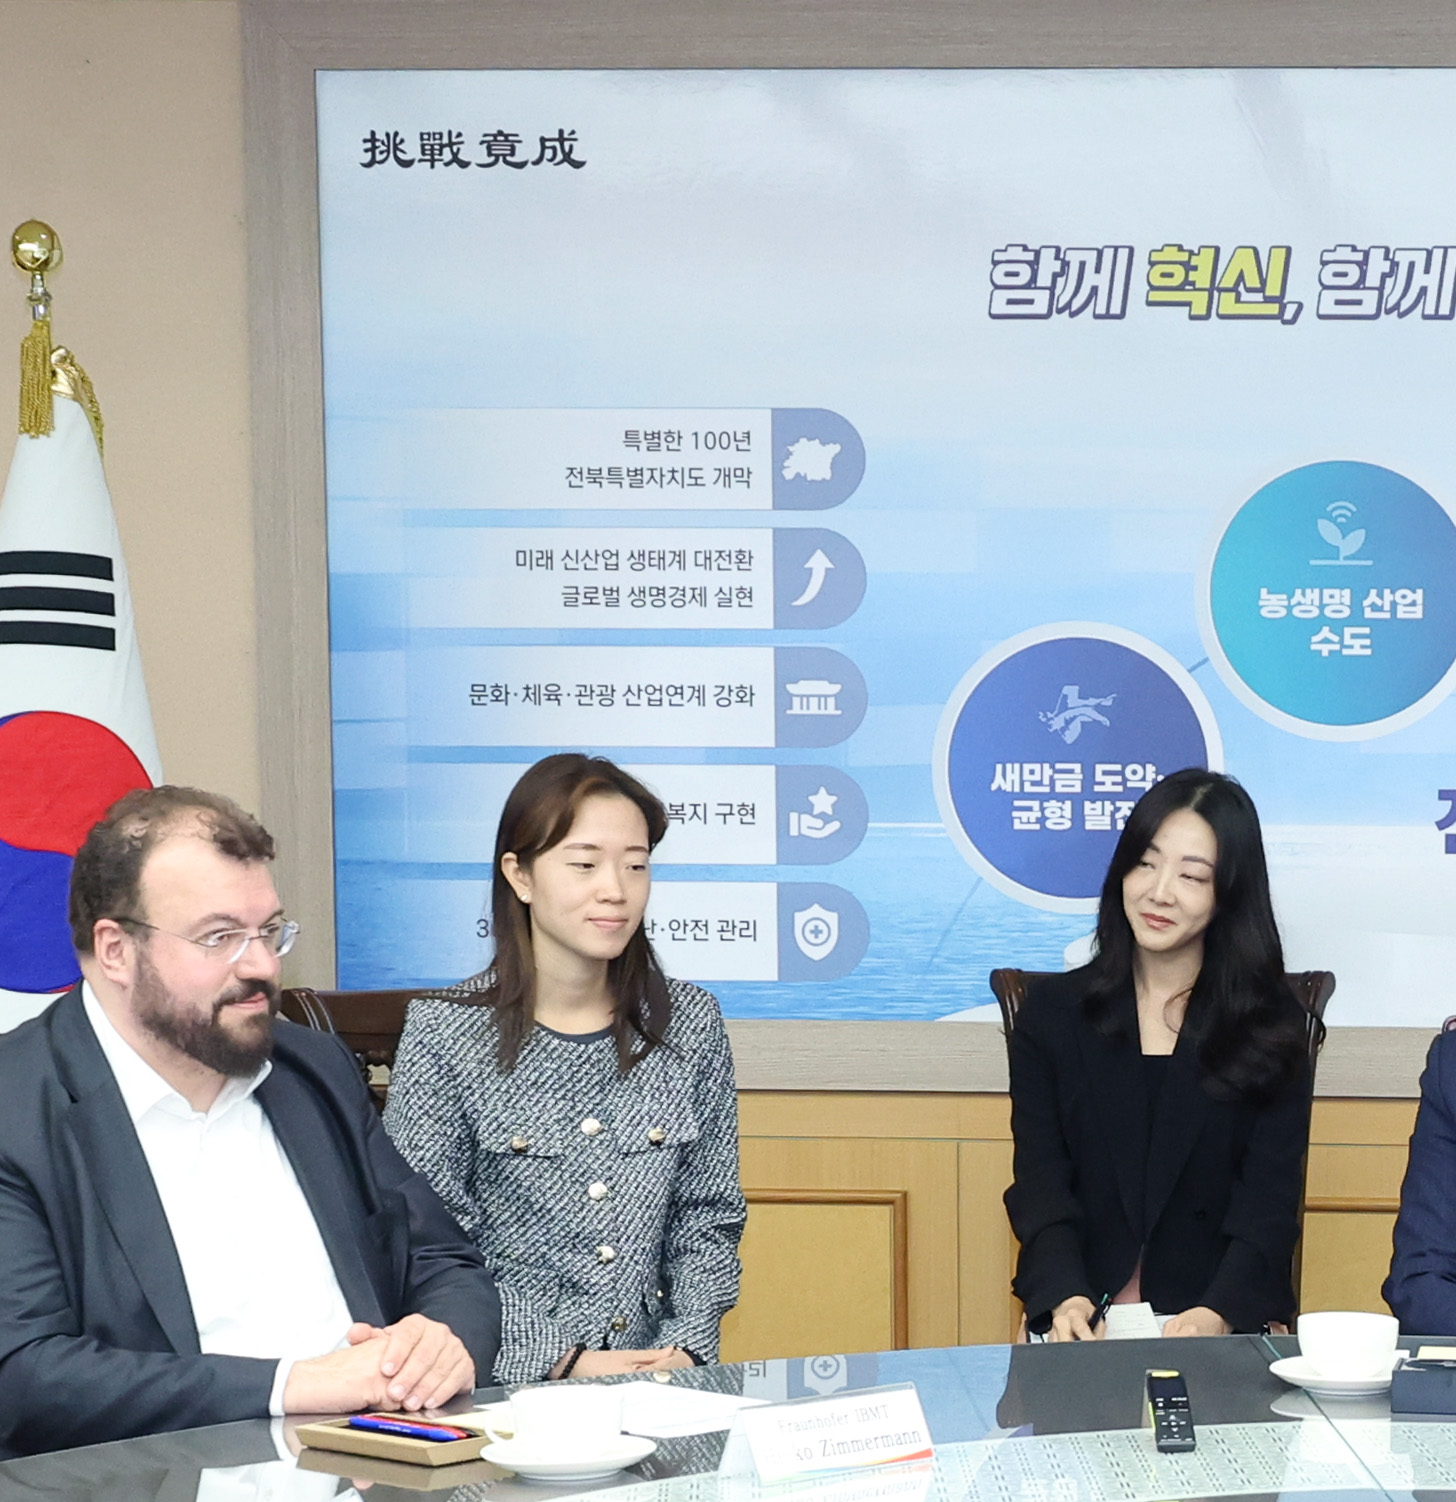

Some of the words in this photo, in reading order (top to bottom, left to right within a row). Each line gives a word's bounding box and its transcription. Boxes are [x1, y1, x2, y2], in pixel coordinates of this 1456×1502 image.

[359, 128, 589, 171] 挑戰竟成
[989, 244, 1135, 320] 함께
[1146, 245, 1303, 325] 혁신,
[622, 430, 683, 452] 특별한
[692, 430, 752, 452] 100년
[565, 466, 706, 489] 전북특별자치도
[713, 466, 752, 489] 개막
[516, 549, 554, 571] 미래
[560, 549, 619, 571] 신산업
[627, 549, 687, 571] 생태계
[694, 549, 754, 571] 대전환
[561, 586, 620, 609] 글로벌
[627, 586, 708, 609] 생명경제
[714, 586, 754, 609] 실현
[1257, 587, 1351, 620] 농생명
[1362, 587, 1424, 620] 산업
[1310, 626, 1372, 657] 수도
[469, 683, 616, 707] 문화·체육·관광
[622, 683, 707, 707] 산업연계
[713, 683, 755, 707] 강화
[990, 762, 1084, 793] 새만금
[715, 802, 756, 825] 구현
[1011, 800, 1073, 831] 균형
[716, 919, 757, 942] 관리
[777, 1413, 849, 1433] Fraunhofer
[856, 1404, 889, 1424] IBMT
[819, 1427, 922, 1458] Zimmermann
